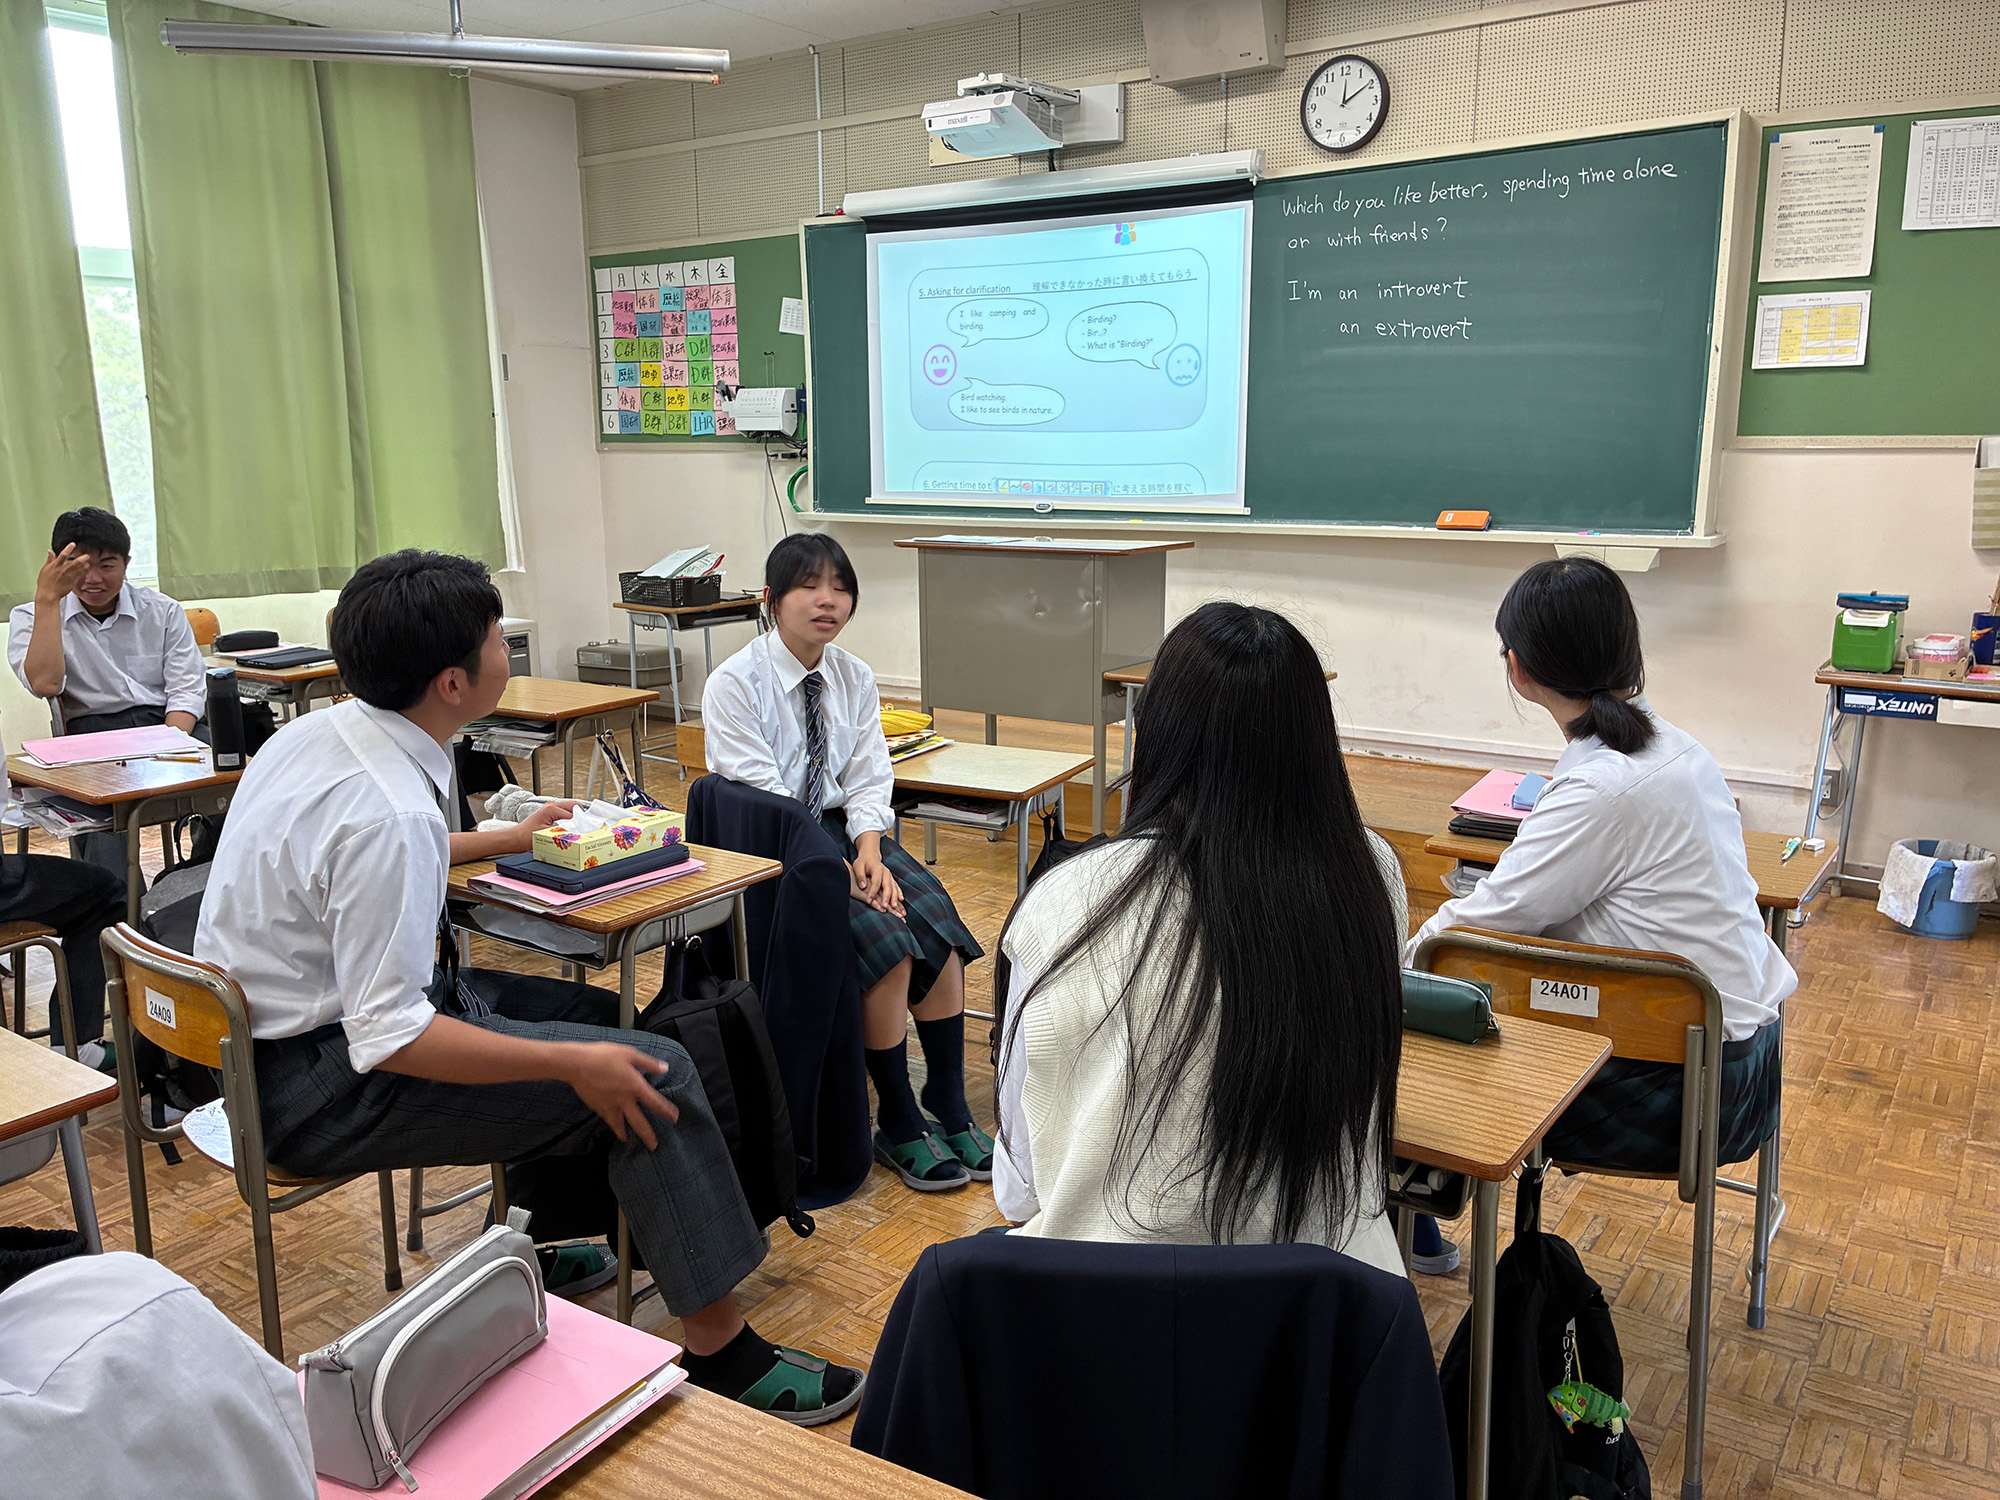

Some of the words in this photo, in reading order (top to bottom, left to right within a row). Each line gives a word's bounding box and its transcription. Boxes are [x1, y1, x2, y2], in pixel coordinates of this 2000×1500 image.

[1340, 65, 1351, 76] 12
[1358, 68, 1363, 79] 1
[1325, 72, 1335, 83] 11
[1368, 79, 1375, 89] 2
[1315, 85, 1326, 97] 10
[1371, 95, 1378, 106] 3
[1310, 103, 1317, 113] 9
[1366, 112, 1373, 122] 4
[1315, 118, 1322, 129] 8
[1326, 129, 1332, 139] 7
[1355, 126, 1361, 136] 5
[1339, 132, 1345, 143] 6
[1282, 189, 1324, 217] Which
[1333, 190, 1350, 211] do
[1353, 198, 1386, 218] you
[1393, 184, 1422, 206] like
[1429, 179, 1489, 203] better,
[1502, 169, 1571, 202] spending
[1578, 165, 1616, 186] time
[1622, 157, 1680, 180] alone
[1287, 236, 1311, 250] or
[1327, 225, 1363, 248] with
[618, 273, 626, 287] 月
[641, 270, 651, 284] 火
[665, 270, 676, 283] 水
[690, 266, 702, 280] 木
[1032, 269, 1192, 292] 理解できなかった時に言い換えてもらう
[919, 289, 926, 297] 5.
[927, 287, 951, 297] Asking
[953, 286, 964, 294] for
[966, 284, 1011, 295] clarification
[1288, 280, 1323, 301] I'm
[1339, 290, 1358, 301] an
[638, 293, 655, 309] 体育
[711, 286, 732, 307] 体育
[989, 309, 1016, 318] camping
[1023, 307, 1036, 316] and
[1087, 314, 1117, 325] Birding?
[601, 320, 608, 333] 2
[960, 322, 984, 332] birding.
[1340, 322, 1360, 335] an
[603, 344, 609, 358] 3
[1087, 342, 1107, 350] What
[1108, 341, 1116, 349] is
[604, 370, 612, 383] 4
[606, 393, 612, 406] 5
[961, 393, 975, 401] Bird
[1002, 406, 1020, 414] birds
[1021, 406, 1028, 414] in
[608, 415, 614, 428] 6
[694, 414, 714, 432] LHR
[931, 480, 958, 490] Getting
[959, 481, 976, 489] time
[978, 482, 986, 490] to
[1876, 697, 1935, 715] UNITEX
[1540, 981, 1589, 1002] 24A01
[149, 1000, 172, 1024] 24A09
